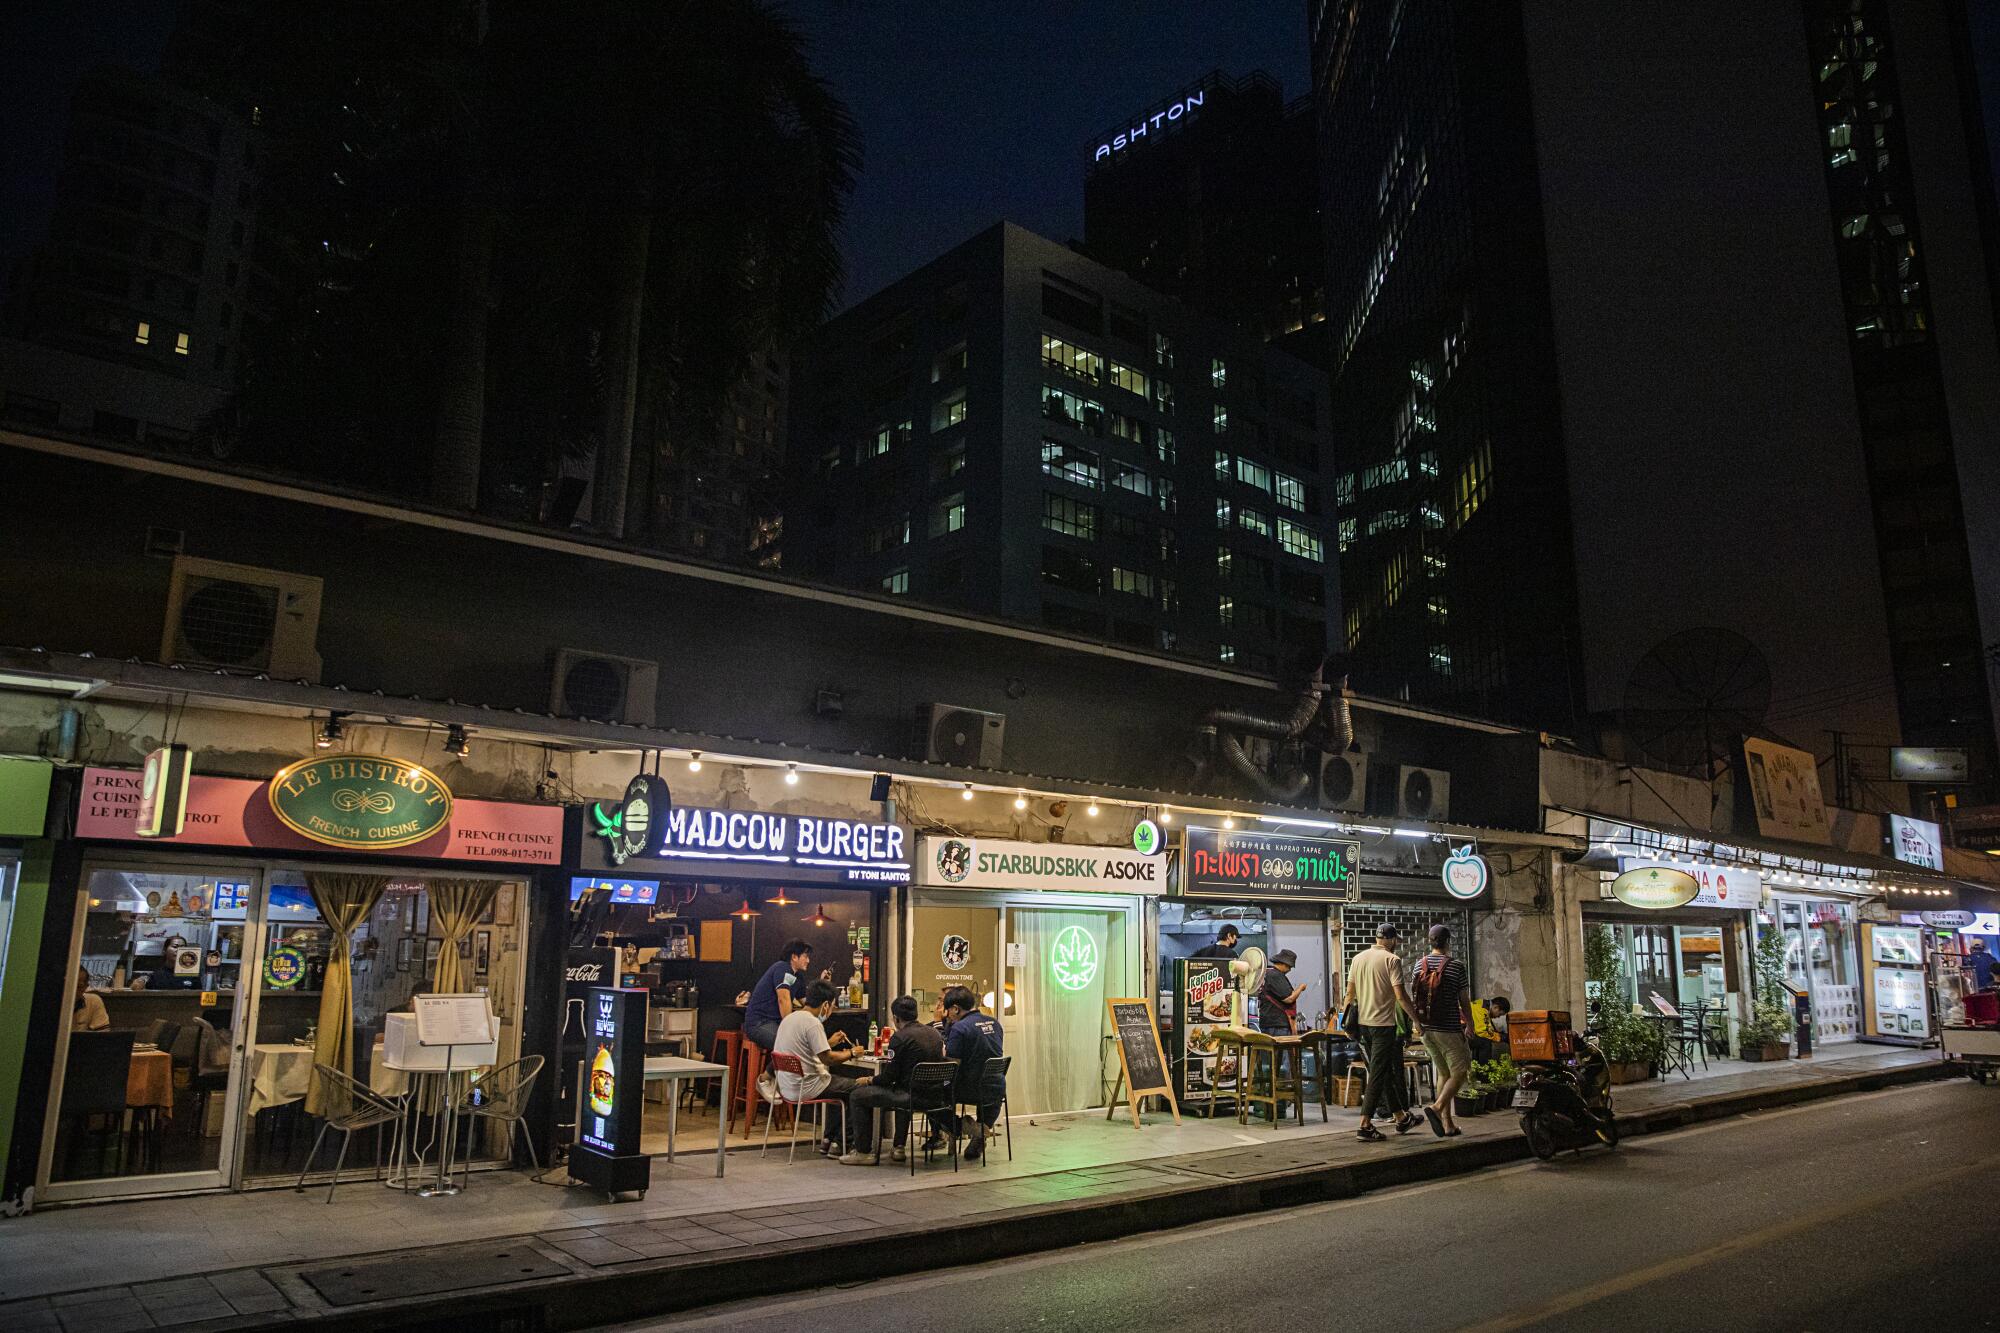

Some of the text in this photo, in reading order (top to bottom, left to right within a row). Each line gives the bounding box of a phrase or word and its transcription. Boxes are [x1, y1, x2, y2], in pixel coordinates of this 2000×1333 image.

[1095, 91, 1205, 161] ASHTON
[95, 776, 144, 790] FRENC
[283, 762, 444, 807] LE BISTROT
[93, 791, 141, 804] CUISIN
[90, 806, 110, 817] LE
[184, 812, 221, 824] TROT
[309, 815, 421, 838] FRENCH CUISINE
[458, 829, 554, 844] FRENCH CUISINE
[664, 808, 786, 851] MADCOW
[797, 818, 904, 861] BURGER
[465, 845, 552, 860] TEL.098-017-3711
[1275, 844, 1321, 855] KAPRAO TAPAE
[977, 852, 1155, 881] STARBUDSBKK ASOKE
[1194, 849, 1259, 879] กะเพรา
[848, 870, 911, 882] BY TONI SANTOS
[1249, 881, 1301, 891] Master of Kaprao
[1190, 968, 1218, 988] Kaprao
